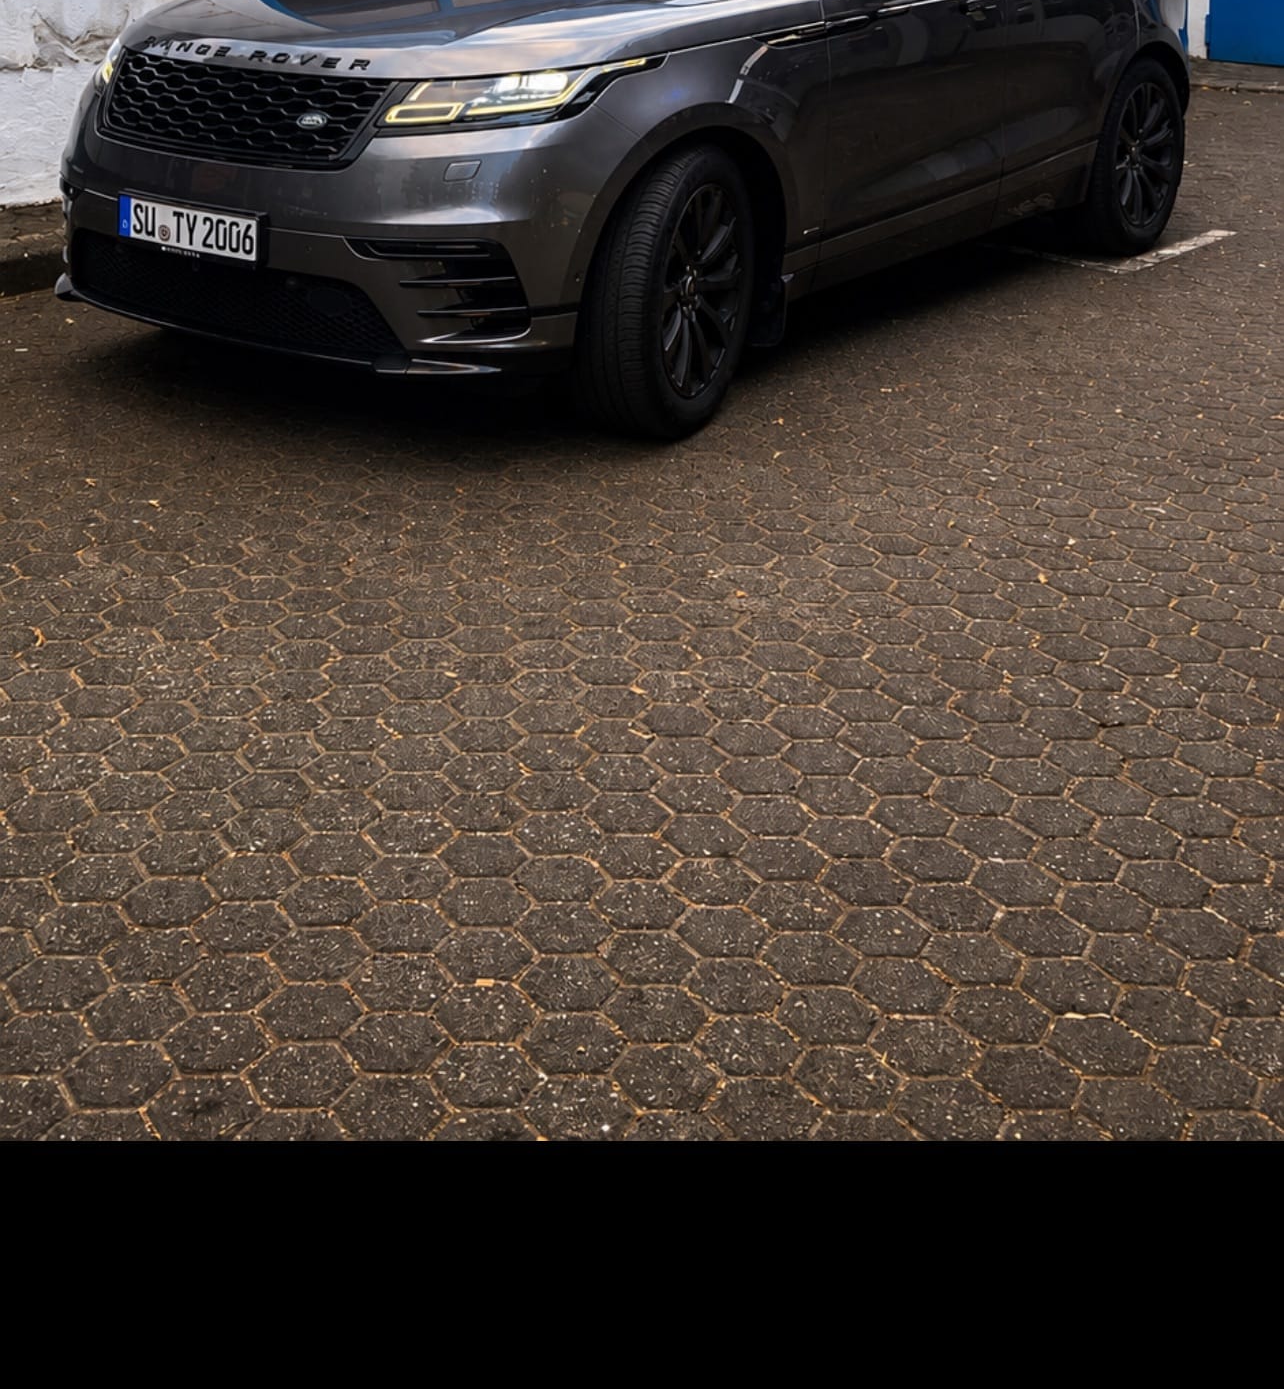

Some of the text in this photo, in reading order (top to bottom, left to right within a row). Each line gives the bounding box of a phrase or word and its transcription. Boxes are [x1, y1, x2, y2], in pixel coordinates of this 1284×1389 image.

[144, 35, 371, 71] RANGE ROVER
[132, 202, 254, 256] SU TY 2006
